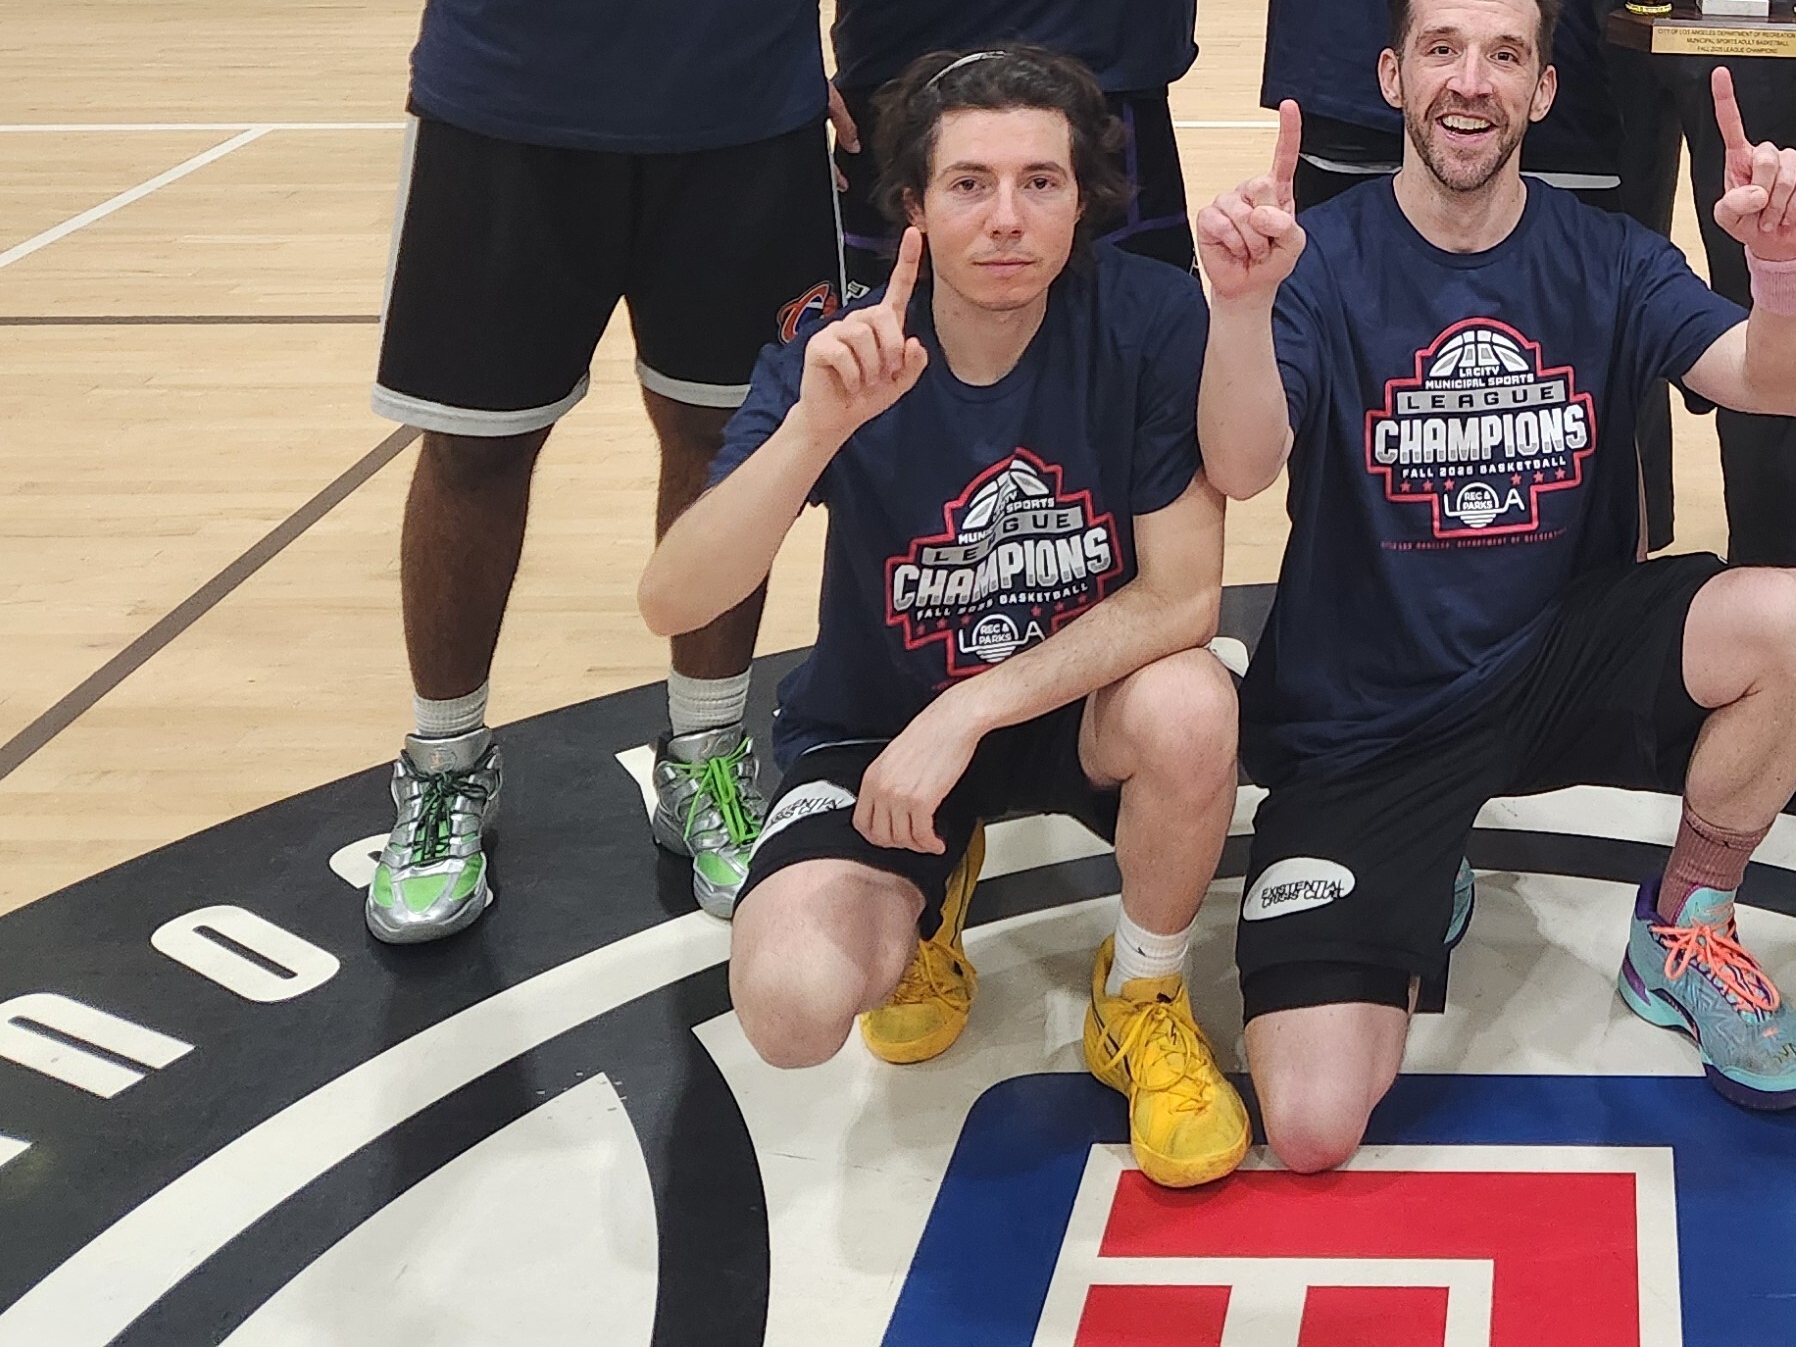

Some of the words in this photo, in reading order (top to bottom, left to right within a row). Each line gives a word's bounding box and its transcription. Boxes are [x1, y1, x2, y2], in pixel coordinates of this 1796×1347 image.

[1425, 377, 1486, 390] MUNICIPAL
[1488, 373, 1535, 387] SPORTS
[1478, 366, 1500, 377] CITY
[1407, 385, 1554, 410] LEAGUE
[1374, 404, 1588, 465] CHAMPIONS
[1402, 467, 1434, 479] FALL
[1480, 456, 1566, 474] BASKETBALL
[1462, 500, 1493, 511] PARKS
[1464, 491, 1483, 501] REC
[893, 526, 1112, 612] CHAMPIONS
